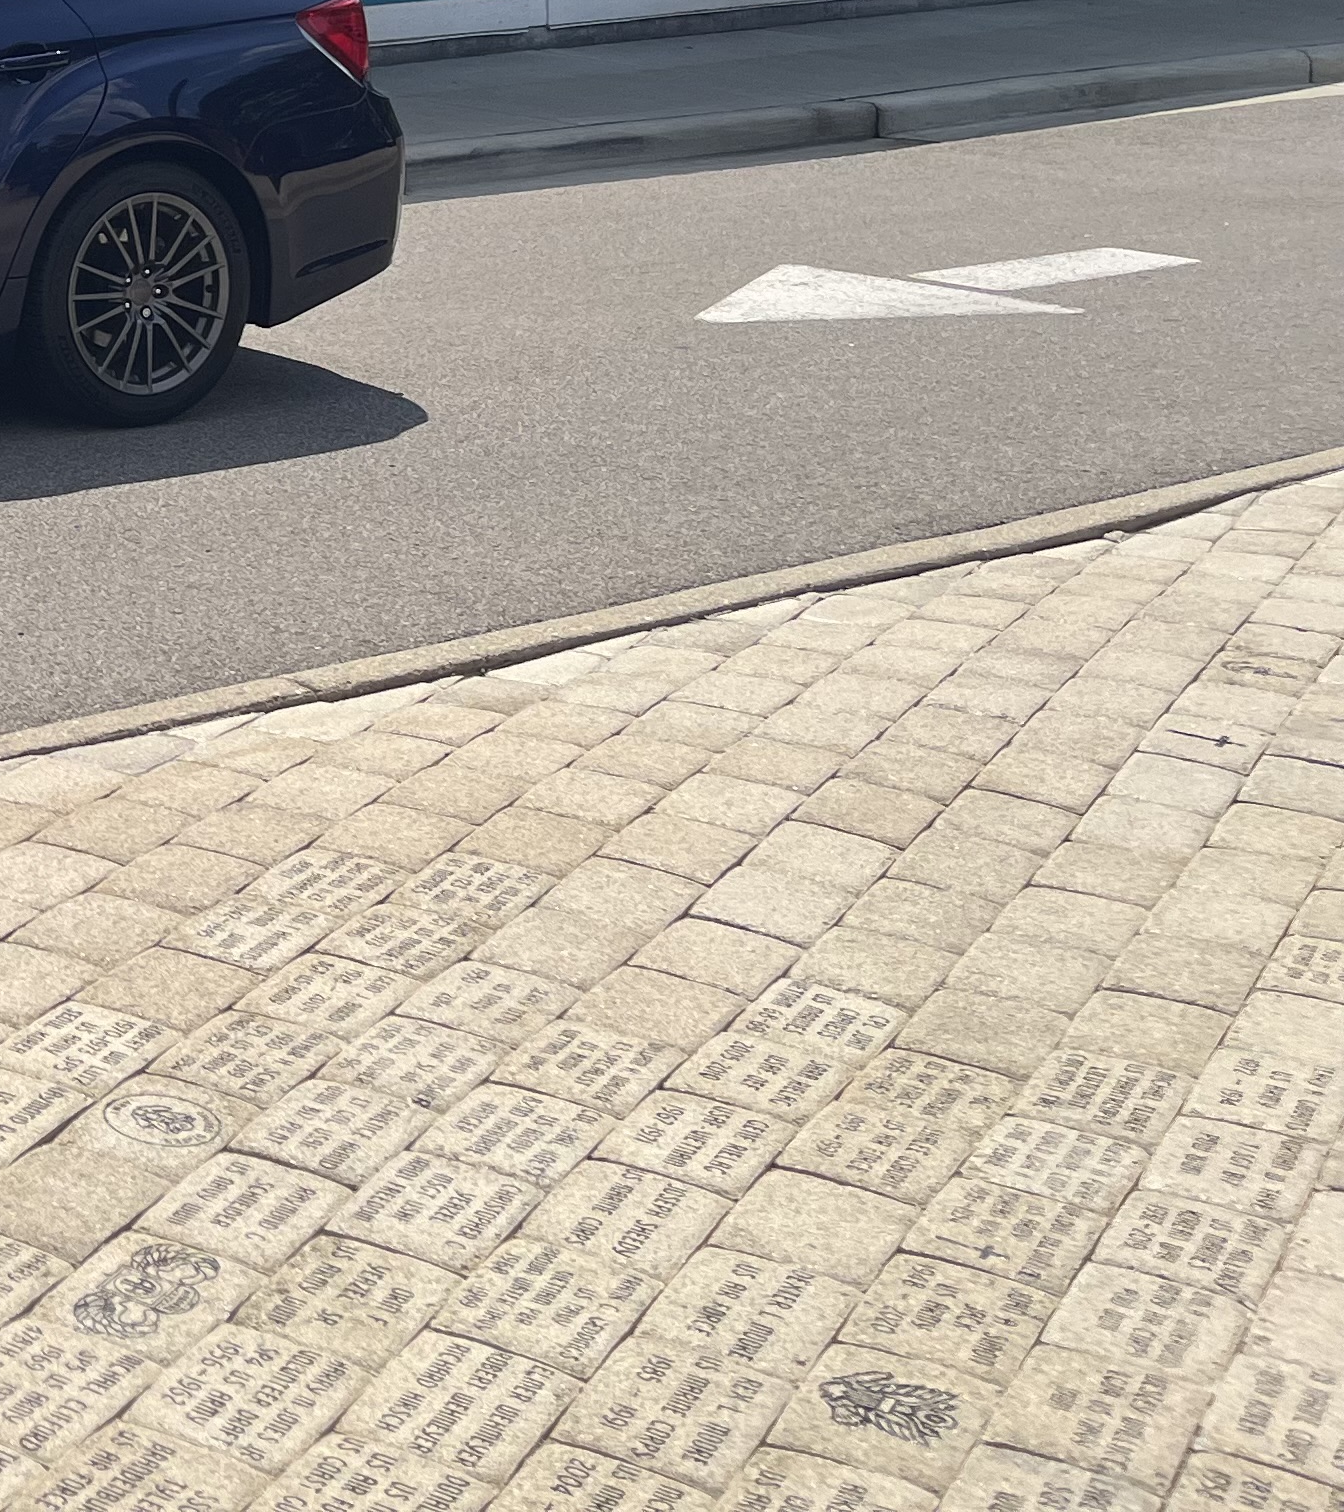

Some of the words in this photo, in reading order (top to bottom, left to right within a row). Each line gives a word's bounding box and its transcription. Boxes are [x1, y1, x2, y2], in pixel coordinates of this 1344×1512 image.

[810, 993, 836, 1006] US
[532, 1114, 560, 1128] US
[733, 1119, 770, 1143] GENE
[881, 1119, 907, 1133] US
[505, 1127, 546, 1154] ARMY
[870, 1133, 898, 1147] AIR
[224, 1161, 253, 1176] US
[620, 1166, 649, 1182] US
[845, 1147, 886, 1174] FORCE
[194, 1175, 235, 1202] NAVY
[415, 1172, 455, 1200] MSGT
[591, 1182, 635, 1216] MARINE
[644, 1183, 689, 1219] JOSEPH
[209, 1179, 276, 1228] SCHNEIDER
[257, 1186, 317, 1230] RAYMOND
[350, 1181, 406, 1223] FREEDOM
[428, 1190, 477, 1224] YEAZEL
[454, 1183, 524, 1240] CHRISTOPHER
[562, 1216, 604, 1246] CORPS
[610, 1219, 660, 1259] SHEEDY
[330, 1243, 360, 1261] US
[296, 1261, 343, 1296] ARMY
[335, 1262, 392, 1301] YEAZEL
[730, 1263, 762, 1280] US
[901, 1263, 937, 1289] 1948
[375, 1287, 415, 1315] ORIN
[572, 1286, 597, 1301] US
[715, 1280, 748, 1300] AIR
[766, 1270, 815, 1310] DEXTER
[931, 1282, 961, 1299] US
[686, 1301, 732, 1337] FORCE
[757, 1309, 785, 1321] L
[869, 1304, 908, 1335] 2020
[909, 1299, 951, 1332] ARMY
[952, 1303, 988, 1332] JACK
[243, 1344, 281, 1368] SP4
[726, 1321, 775, 1362] MOORE
[22, 1344, 66, 1372] 1969
[414, 1342, 471, 1389] RICHARD
[465, 1351, 514, 1391] ROBERT
[635, 1354, 675, 1384] 1985
[693, 1355, 724, 1373] US
[41, 1372, 72, 1391] US
[80, 1354, 145, 1396] MICHAEL
[222, 1369, 255, 1389] US
[248, 1349, 323, 1408] VOLUNTEER
[303, 1359, 350, 1396] HARRY
[508, 1364, 556, 1403] ELMER
[726, 1376, 764, 1404] REX
[0, 1390, 51, 1425] ARMY
[183, 1389, 234, 1426] ARMY
[290, 1394, 317, 1409] M
[660, 1373, 712, 1418] MARINE
[17, 1398, 88, 1453] CLIFFORD
[255, 1407, 302, 1444] JONES
[374, 1390, 426, 1433] HIRSCH
[407, 1392, 476, 1454] WEHMEYER
[598, 1402, 638, 1432] 1991
[109, 1429, 141, 1449] US
[210, 1408, 260, 1447] DRAFT
[451, 1404, 521, 1468] WEHMEYER
[629, 1419, 676, 1460] CORPS
[239, 1443, 268, 1462] JR
[336, 1436, 368, 1454] US
[680, 1421, 732, 1466] MOORE
[83, 1448, 121, 1472] AIR
[298, 1455, 349, 1494] COAST
[364, 1452, 399, 1473] US
[610, 1463, 642, 1483] US
[34, 1470, 95, 1512] FORCE
[340, 1472, 379, 1496] AIR
[382, 1480, 419, 1502] US
[549, 1458, 597, 1496] 2004
